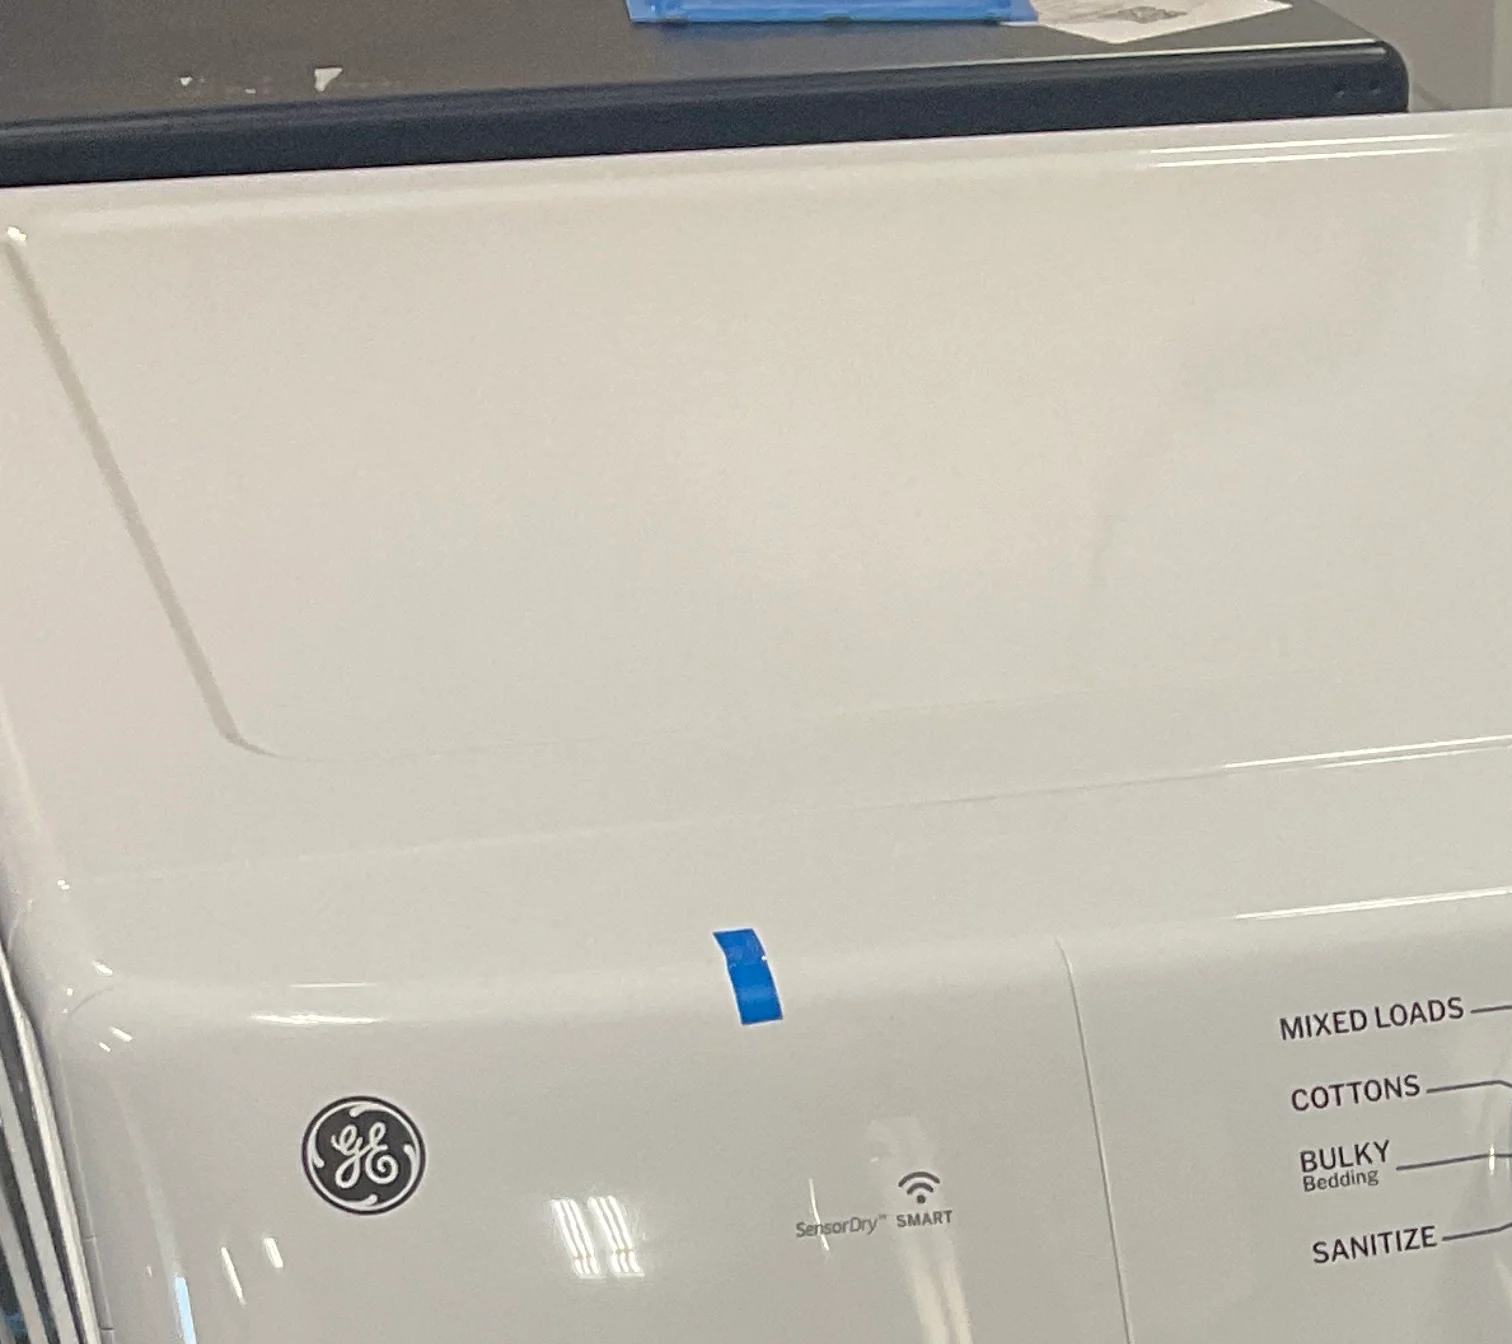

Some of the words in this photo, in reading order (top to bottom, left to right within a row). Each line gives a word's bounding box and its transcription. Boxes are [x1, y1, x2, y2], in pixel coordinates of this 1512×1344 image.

[1279, 1010, 1367, 1041] MIXED
[1374, 997, 1465, 1028] LOADS
[1291, 1074, 1421, 1111] COTTONS
[1300, 1139, 1390, 1173] BULKY
[1302, 1169, 1379, 1192] Bedding
[896, 1209, 953, 1228] SMART
[1312, 1225, 1438, 1264] SANITIZE
